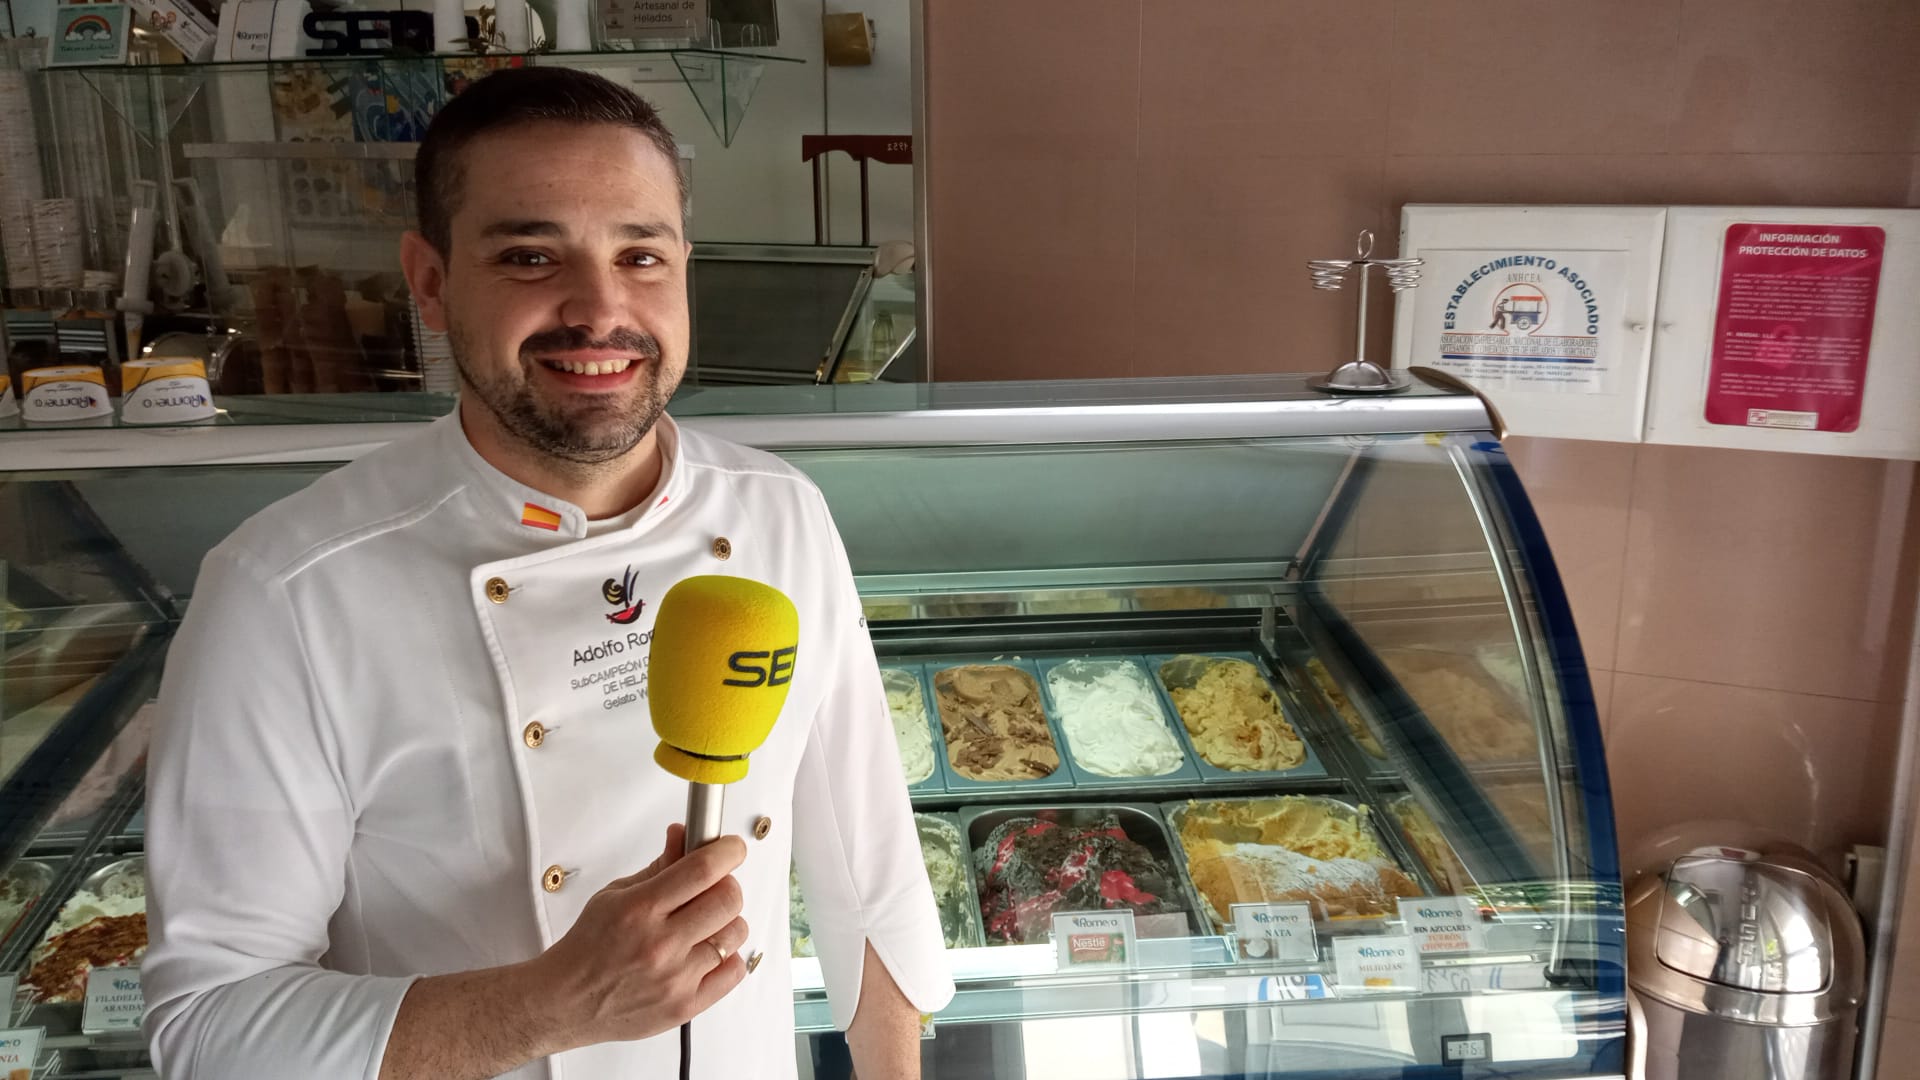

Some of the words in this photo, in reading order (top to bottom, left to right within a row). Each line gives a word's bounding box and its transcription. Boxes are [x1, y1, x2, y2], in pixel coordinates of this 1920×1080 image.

[633, 0, 680, 10] Artesanal
[682, 0, 695, 10] de
[633, 14, 673, 23] Helados
[1758, 232, 1841, 245] INFORMACIÓN
[1738, 245, 1809, 257] PROTECCIÓN
[1811, 247, 1827, 257] DE
[1829, 248, 1869, 258] DATOS
[1443, 255, 1557, 330] ESTABLECIMIENTO
[1557, 266, 1599, 335] ASOCIADO
[35, 395, 90, 408] Romero
[142, 394, 202, 408] Romero
[573, 639, 625, 667] Adolfo
[722, 642, 798, 688] SE
[570, 658, 642, 690] SubCAMPEÓN
[602, 680, 619, 695] DE
[619, 672, 648, 690] HELA
[602, 692, 637, 710] Gelato
[1259, 912, 1299, 924] Romero
[1423, 907, 1463, 918] Romero
[1078, 917, 1118, 928] Romero
[1264, 929, 1292, 938] NATA
[1363, 946, 1405, 959] Romero
